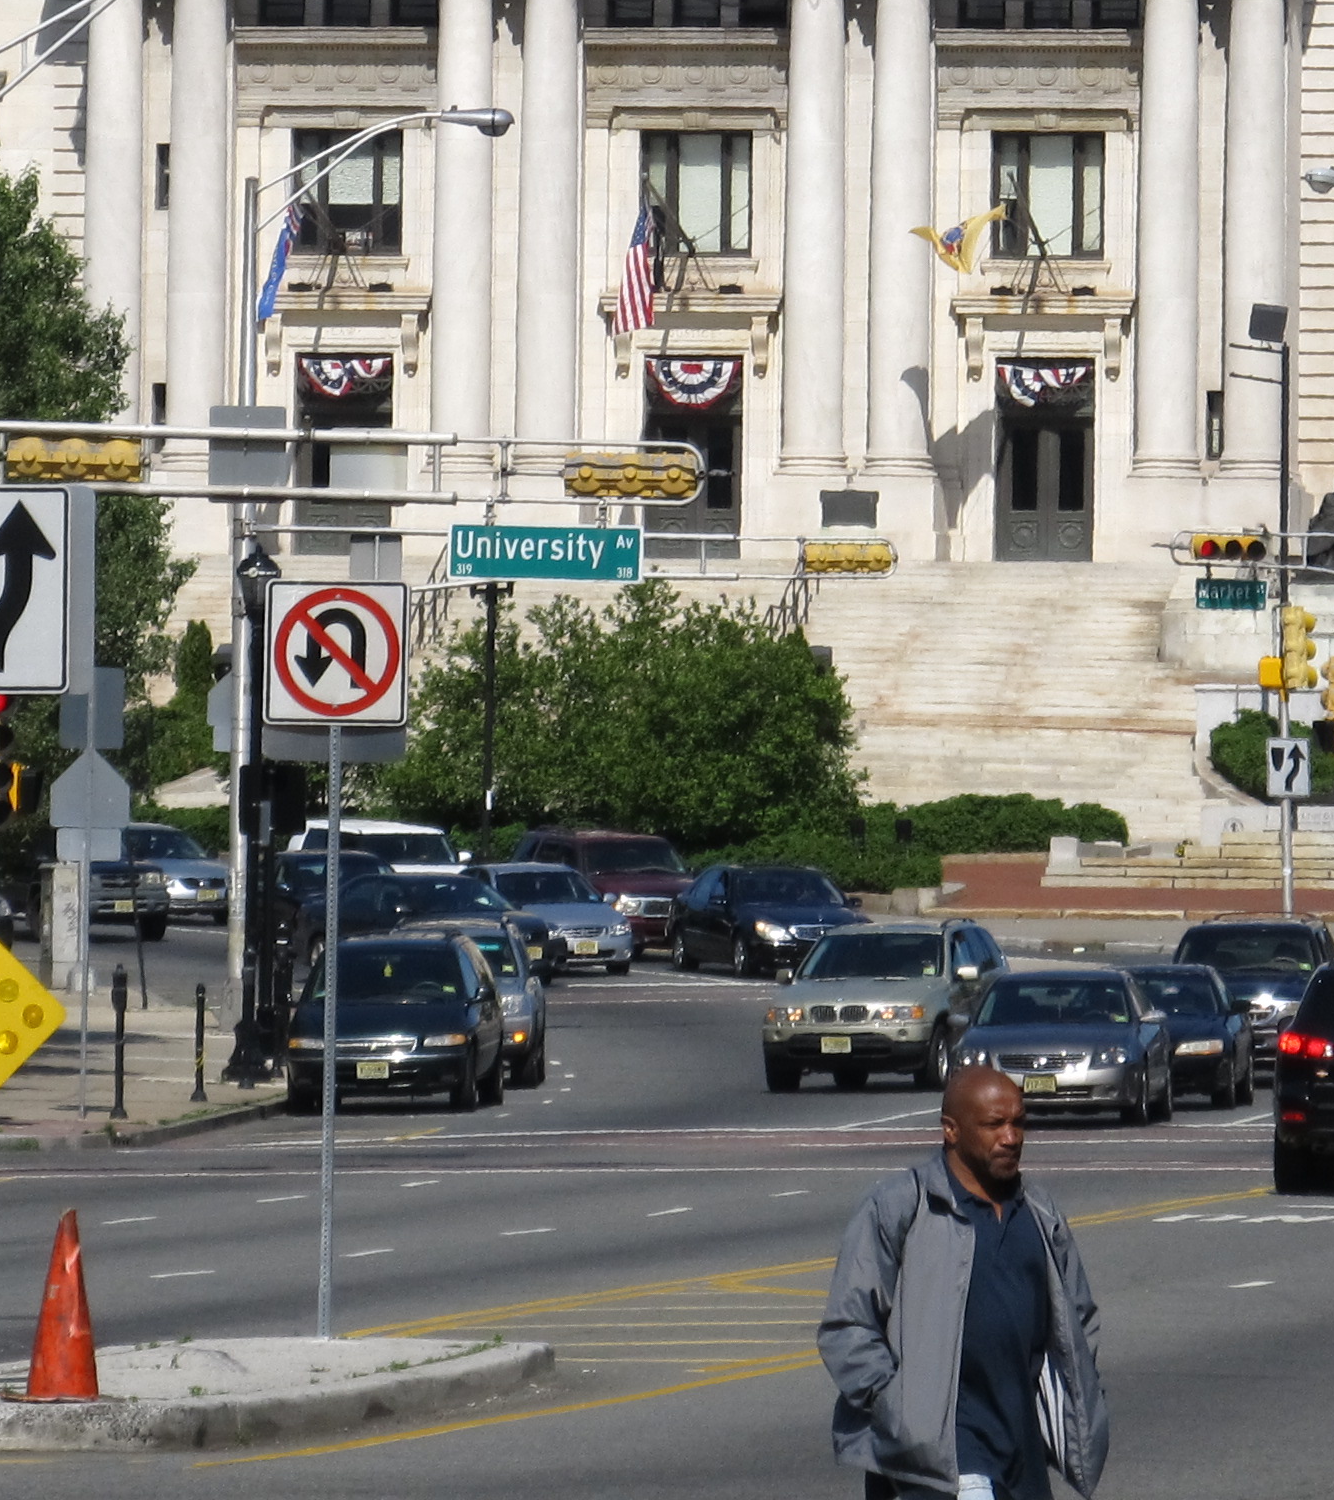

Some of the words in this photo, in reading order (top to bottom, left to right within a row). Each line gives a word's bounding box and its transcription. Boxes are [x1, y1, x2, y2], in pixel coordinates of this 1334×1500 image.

[456, 530, 605, 570] University
[615, 534, 635, 549] Av
[455, 563, 473, 575] 319
[616, 566, 634, 579] 318
[1198, 583, 1251, 599] Market
